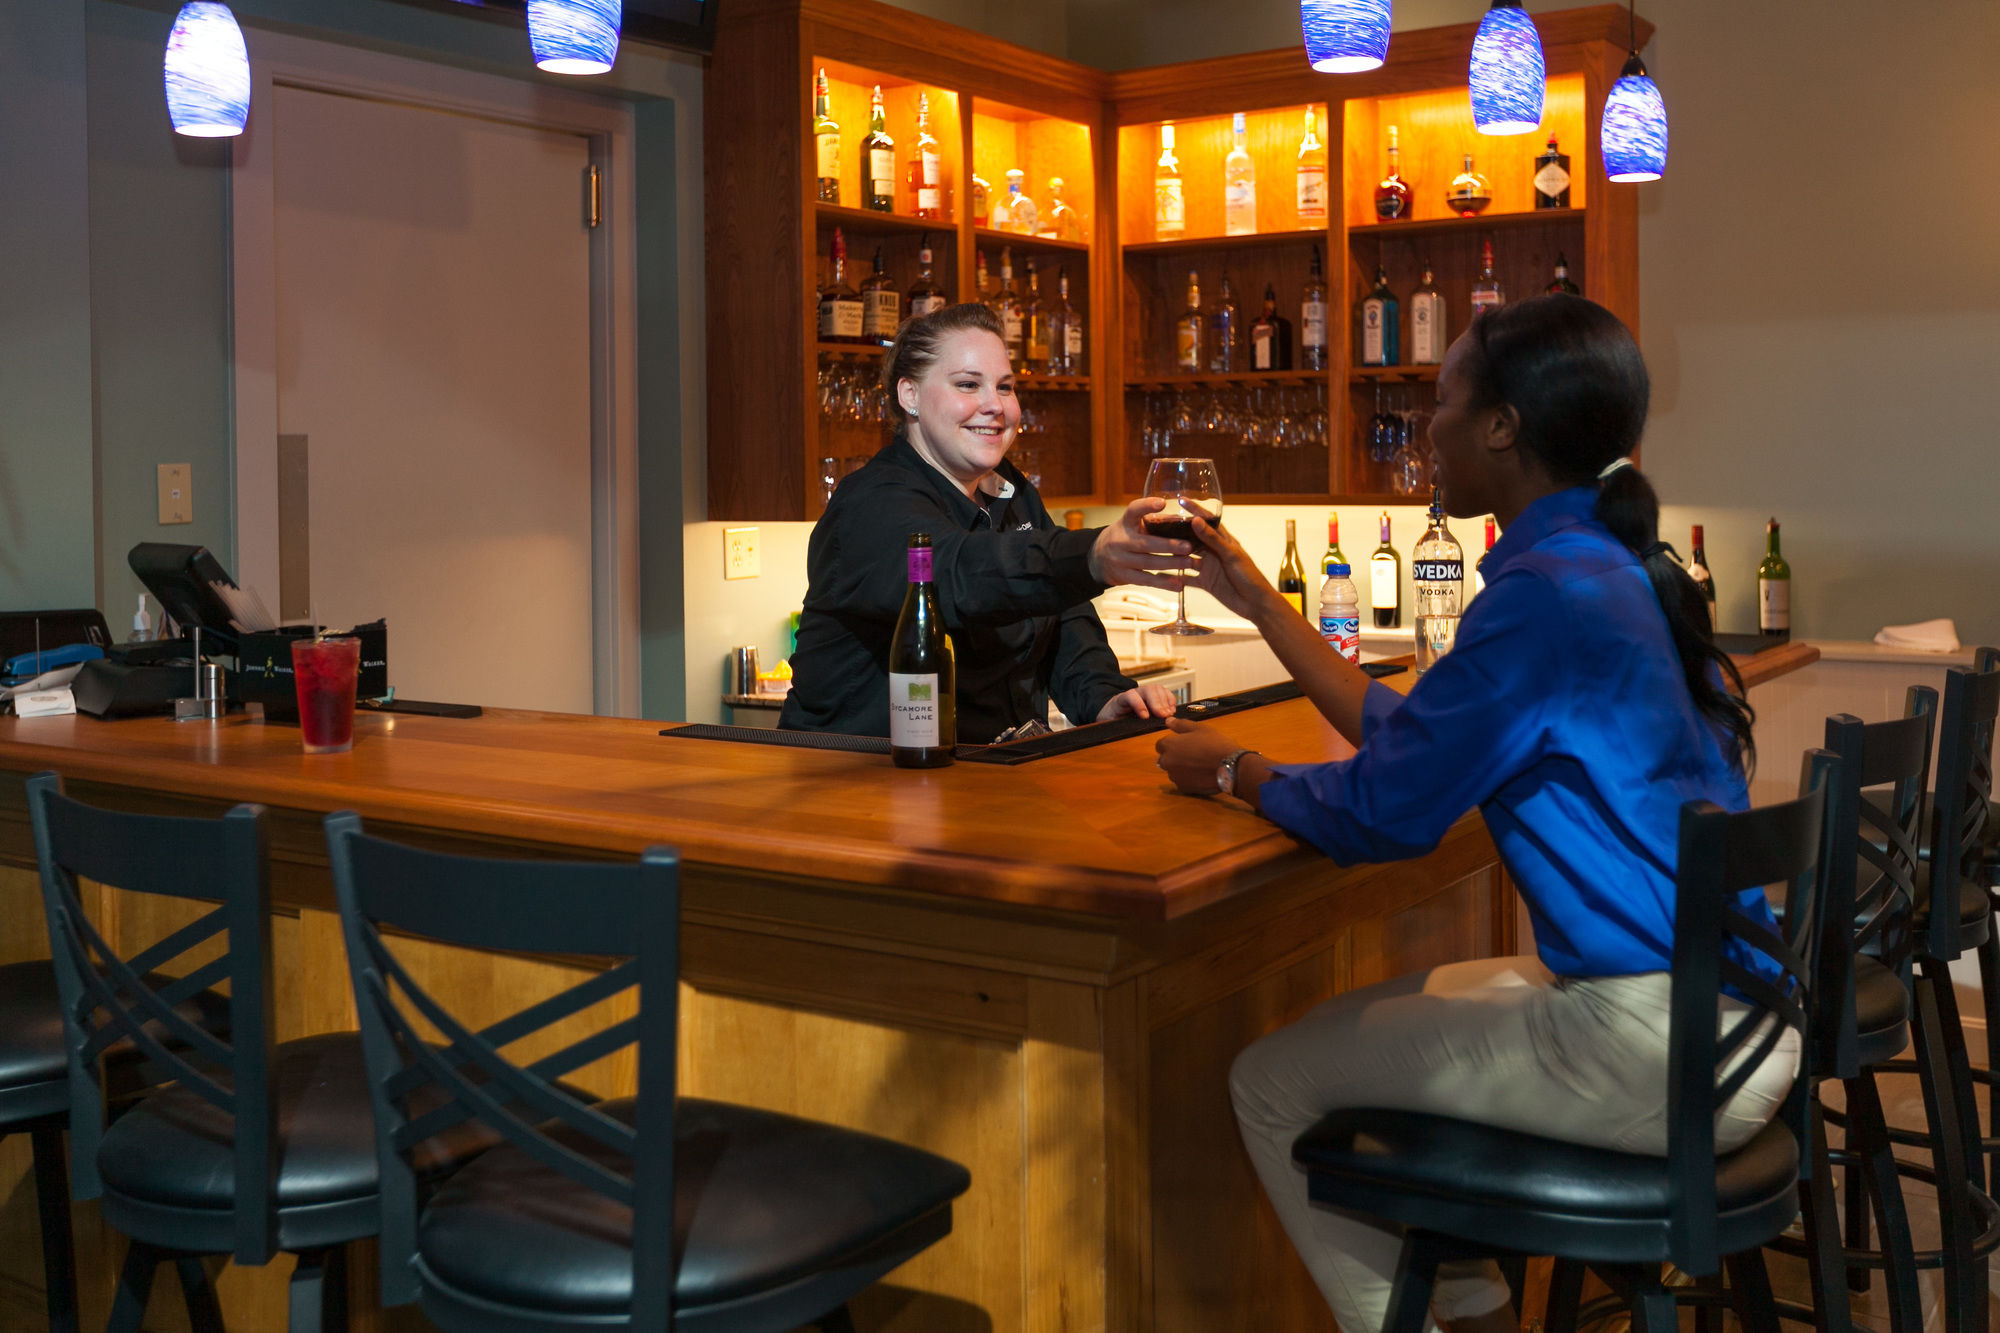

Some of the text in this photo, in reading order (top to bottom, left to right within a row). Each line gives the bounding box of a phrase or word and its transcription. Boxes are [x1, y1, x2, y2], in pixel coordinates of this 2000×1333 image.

[1413, 564, 1463, 579] SVEDKA
[1420, 588, 1454, 596] VODKA
[908, 713, 933, 721] LANE
